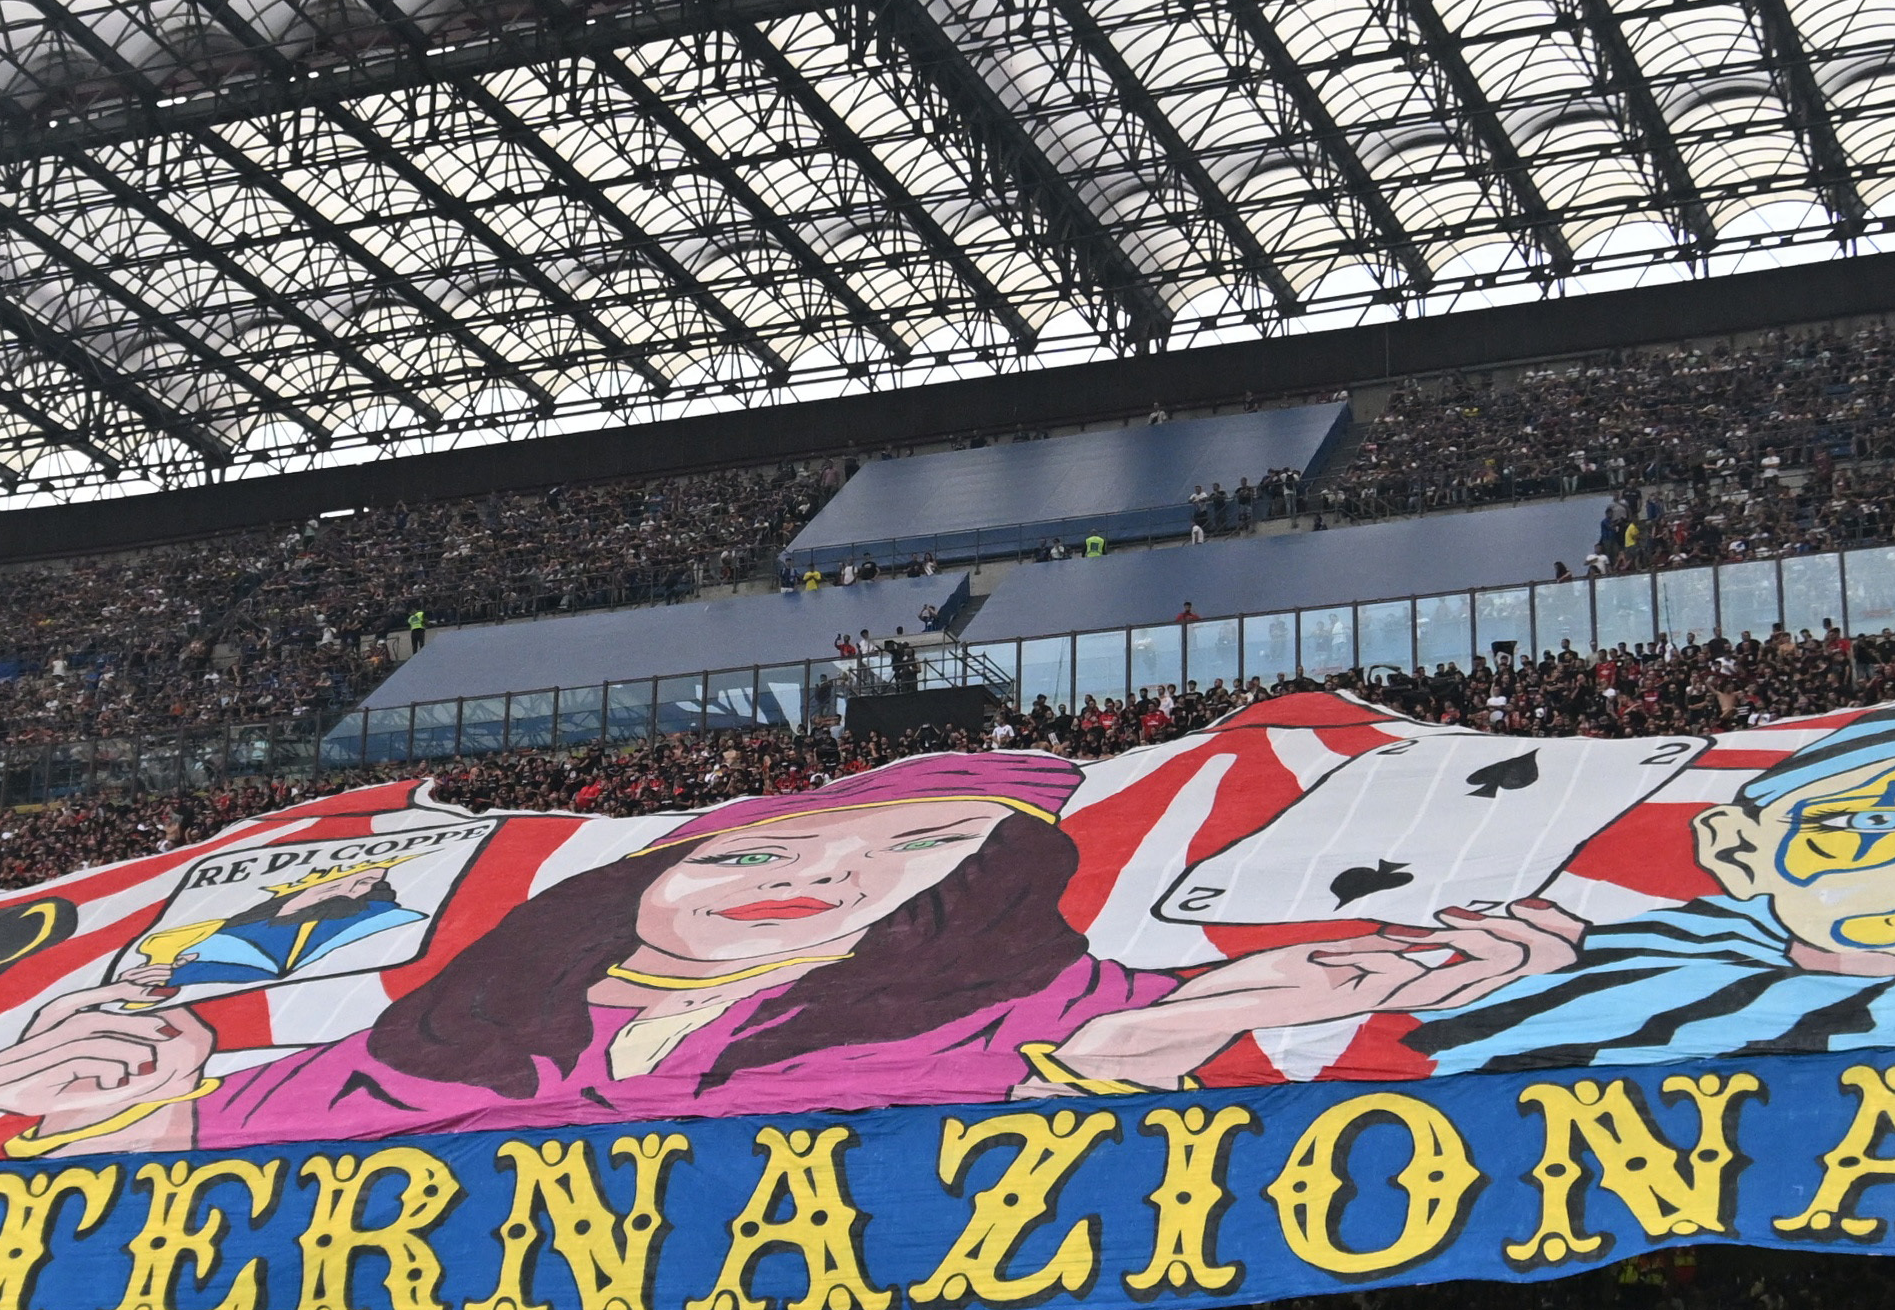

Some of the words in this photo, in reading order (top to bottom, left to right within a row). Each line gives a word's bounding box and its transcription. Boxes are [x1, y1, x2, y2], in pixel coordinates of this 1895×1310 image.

[184, 856, 259, 890] RE
[260, 848, 317, 876] DI
[329, 823, 490, 861] COPPE
